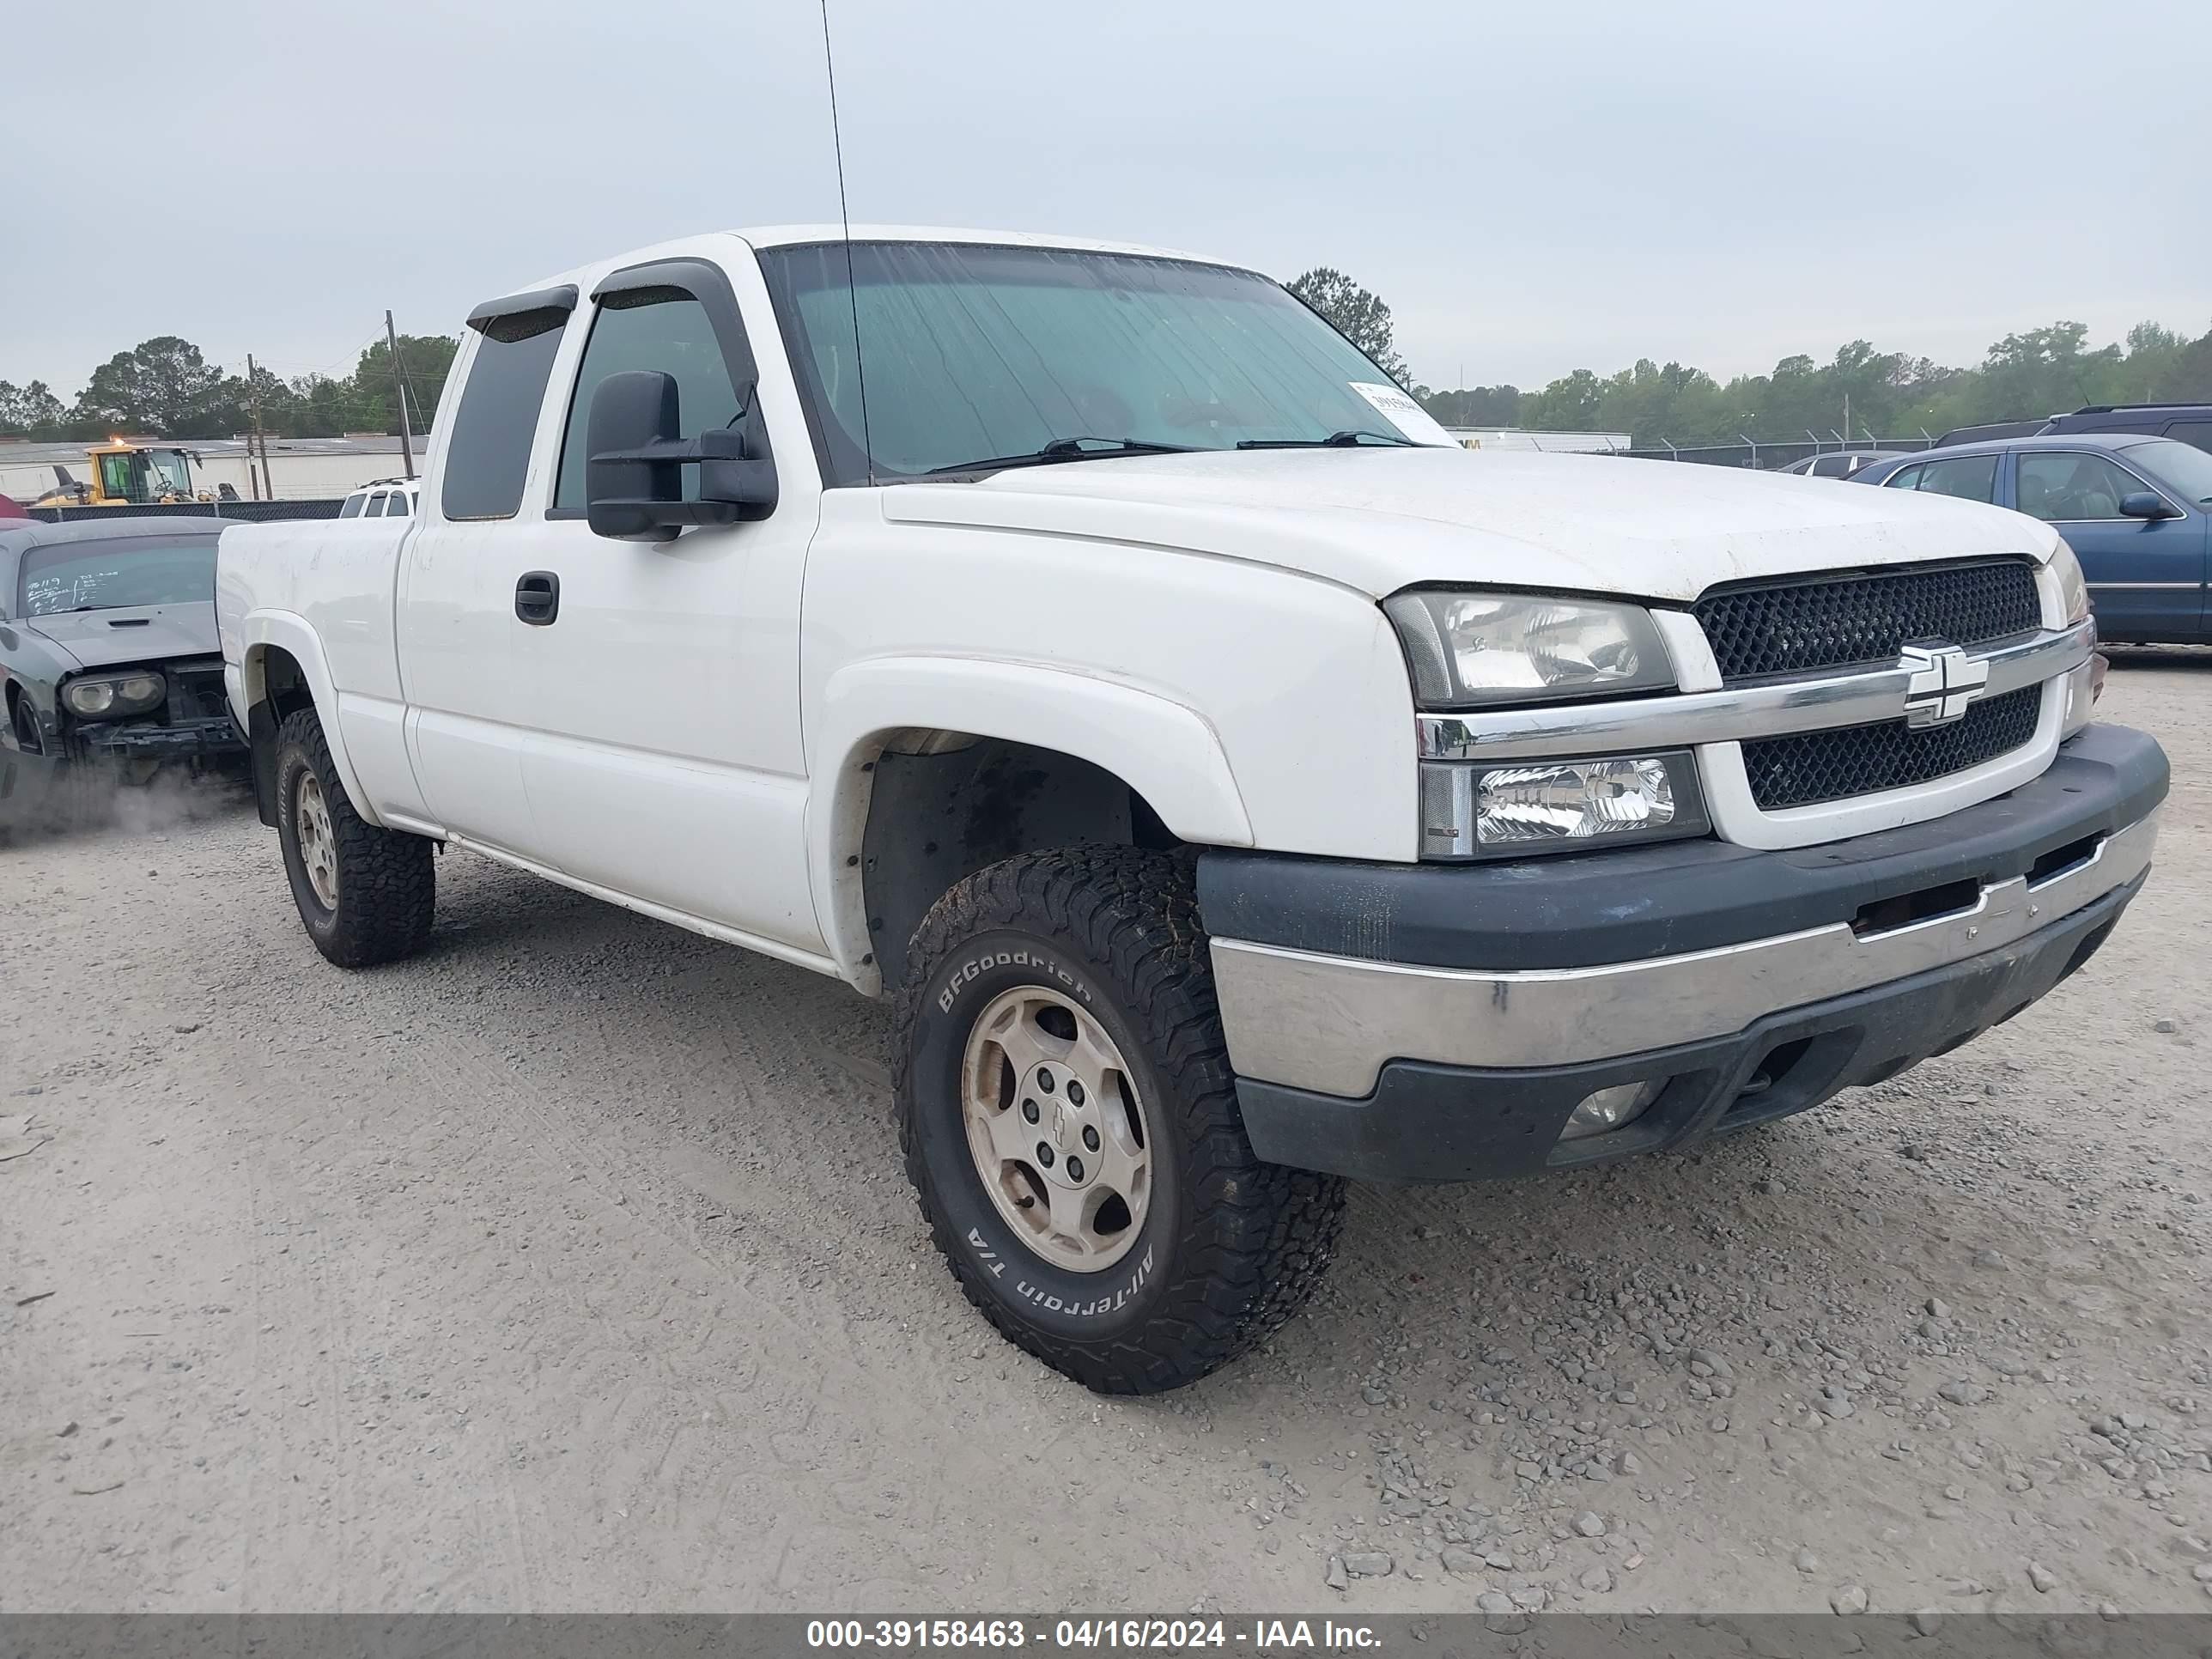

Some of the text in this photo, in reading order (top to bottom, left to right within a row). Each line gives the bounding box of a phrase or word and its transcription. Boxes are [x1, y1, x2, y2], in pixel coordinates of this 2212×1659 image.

[938, 951, 1093, 1014] BFGoodrich
[969, 1227, 1154, 1319] All-Terrain T/A
